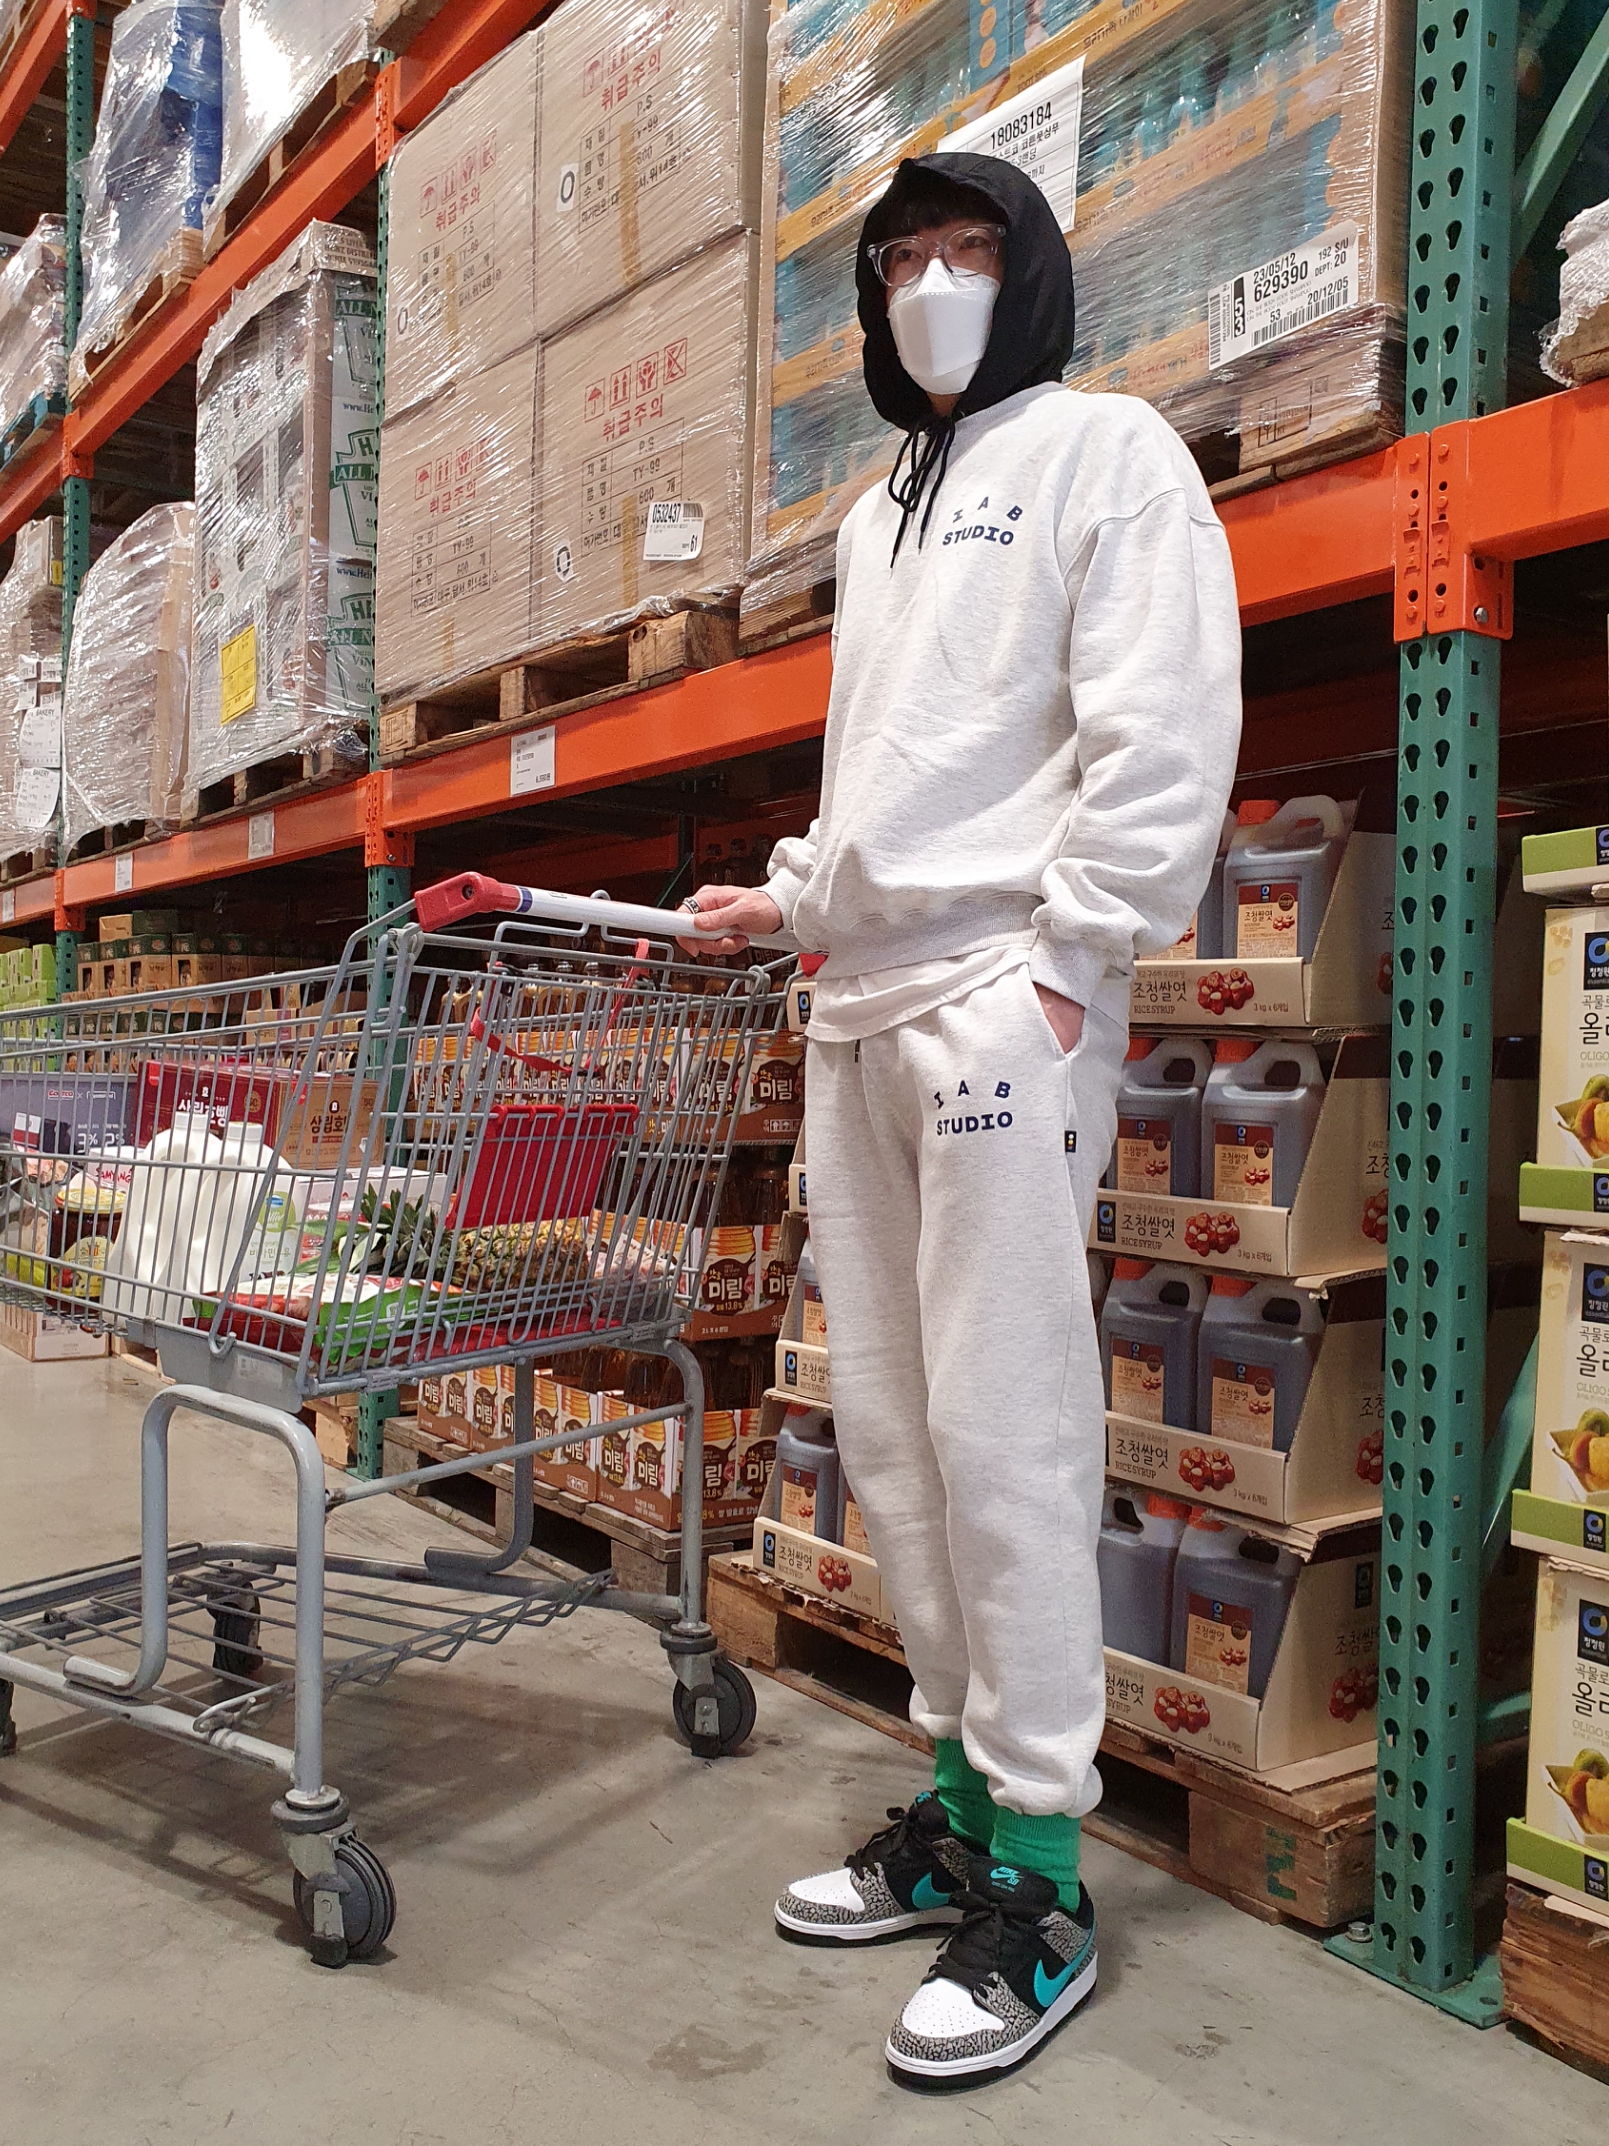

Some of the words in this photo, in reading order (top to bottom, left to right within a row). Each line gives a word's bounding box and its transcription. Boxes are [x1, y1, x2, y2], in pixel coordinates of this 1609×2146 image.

[601, 48, 661, 111] 취급주의
[991, 102, 1052, 150] 18083184
[436, 183, 480, 232] 취급주의
[1253, 252, 1296, 285] 23/05/12
[1318, 246, 1332, 261] 192
[1335, 237, 1349, 253] S/U
[1254, 260, 1308, 303] 629390
[1314, 262, 1333, 277] DEPT:
[1334, 251, 1347, 268] 20
[1270, 308, 1281, 323] 53
[1307, 276, 1349, 306] 20/12/05
[603, 393, 664, 442] 취급주의
[337, 466, 365, 480] ALL
[633, 458, 661, 482] TY-99
[652, 503, 681, 523] 0532437
[690, 535, 698, 552] 61
[942, 525, 1014, 546] STUDIO
[1133, 980, 1188, 1003] 조청쌀엿
[760, 1078, 793, 1101] 미림
[937, 1111, 1013, 1136] STUDIO
[1121, 1213, 1176, 1240] 조청쌀엿
[708, 1277, 743, 1301] 미림
[476, 1402, 493, 1425] 미림
[604, 1449, 624, 1474] 미림
[1115, 1438, 1169, 1470] 조청쌀엿
[638, 1460, 659, 1487] 미림
[704, 1464, 722, 1488] 림
[778, 1545, 812, 1573] 조청쌀엿
[1583, 1636, 1605, 1650] 청정원
[1105, 1672, 1144, 1706] 청쌀엿
